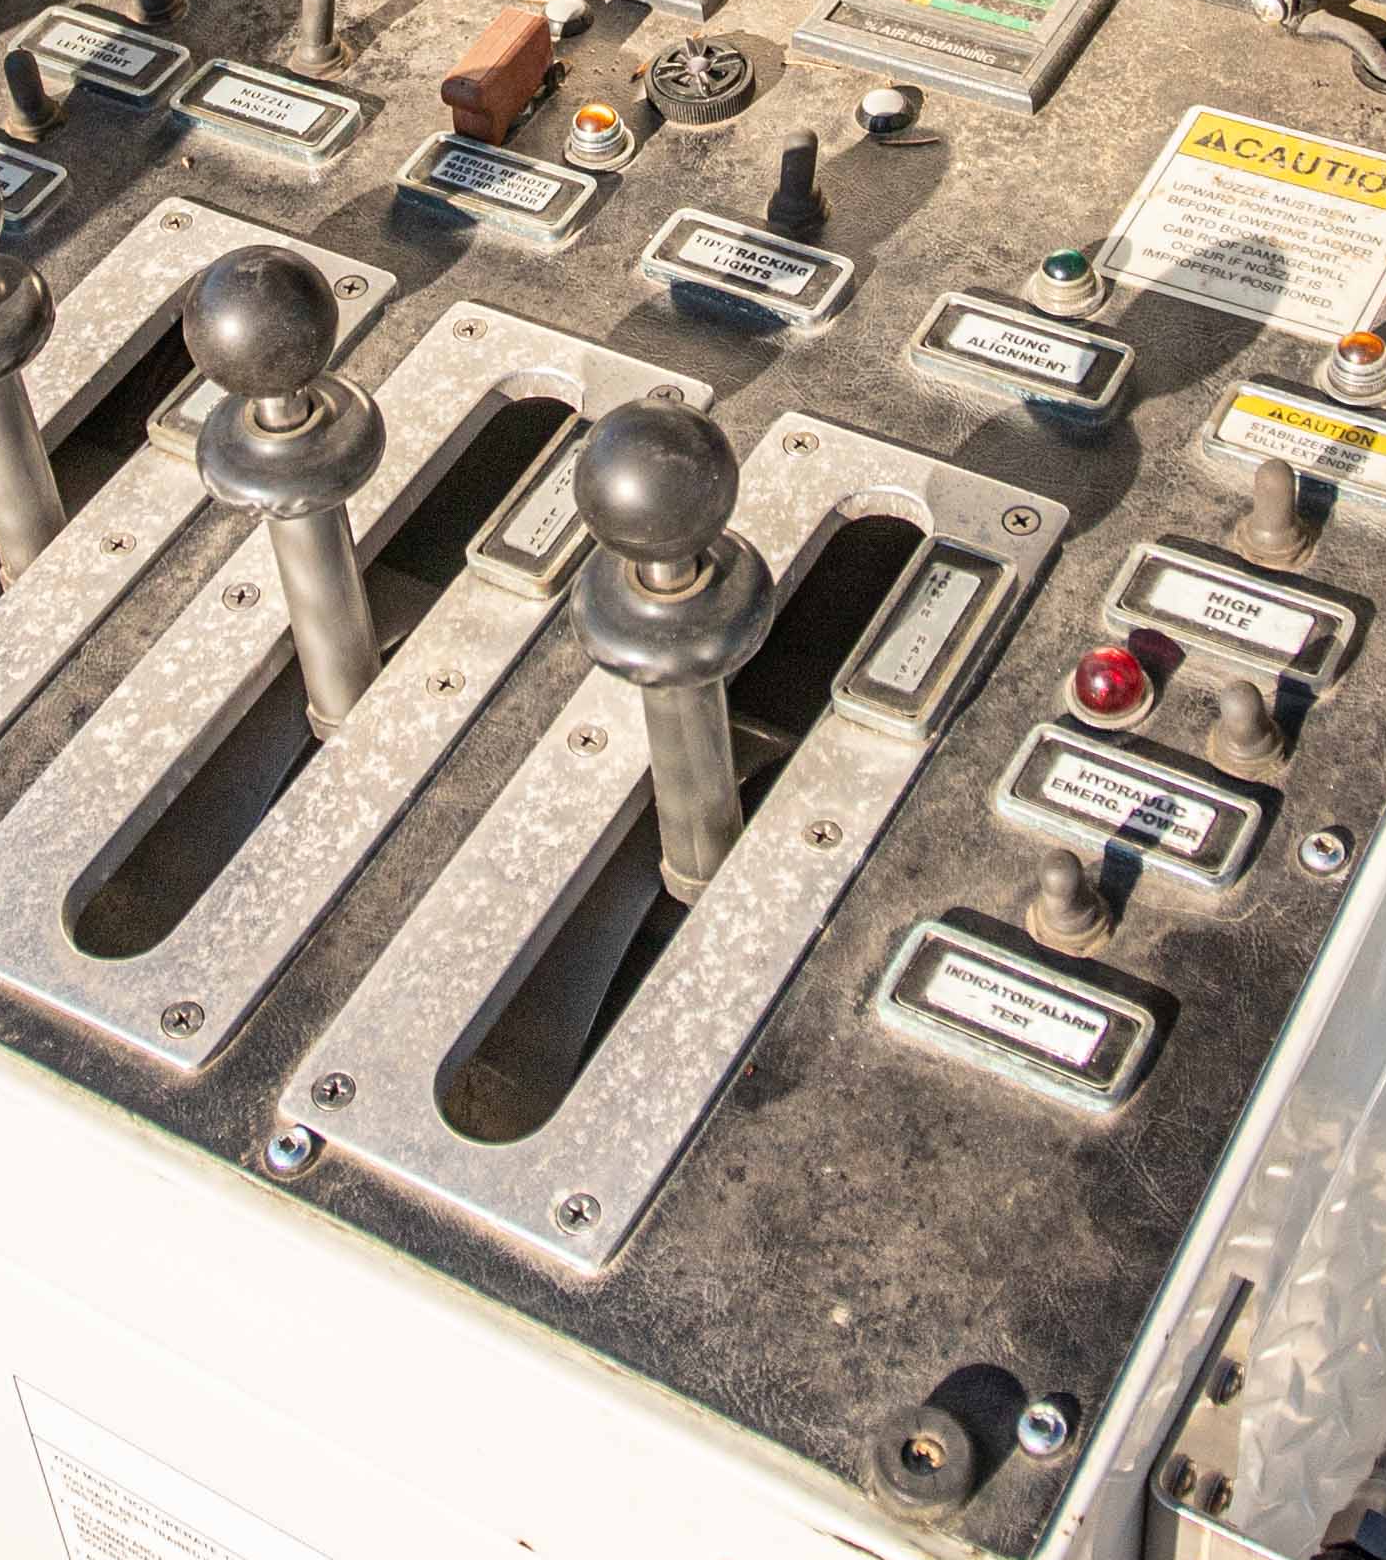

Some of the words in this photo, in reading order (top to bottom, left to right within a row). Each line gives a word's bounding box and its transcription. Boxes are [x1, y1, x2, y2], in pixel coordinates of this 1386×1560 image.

[76, 33, 130, 56] NOZZLE
[879, 24, 907, 39] AIR
[909, 31, 997, 64] REMAINING
[229, 97, 288, 122] MASTER
[240, 87, 295, 110] NOZZLE
[440, 170, 467, 183] AND
[469, 179, 538, 205] INDICATOR
[445, 161, 496, 182] MASTER
[500, 178, 546, 198] SWITCH
[453, 155, 497, 173] AERIAL
[499, 168, 550, 190] REMOTE
[1167, 194, 1227, 217] BEFORE
[1230, 210, 1309, 241] LOWERING
[1313, 234, 1374, 258] LADDER
[1173, 180, 1237, 205] UPWARD
[1238, 199, 1311, 227] POINTING
[1313, 219, 1383, 247] POSITION
[1273, 194, 1315, 213] MUST
[1317, 206, 1338, 219] BE
[1341, 212, 1357, 224] IN
[1182, 213, 1216, 229] INTO
[1220, 224, 1267, 244] BOOM
[696, 234, 809, 277] TIP/TRACKING
[714, 255, 773, 280] LIGHTS
[1163, 224, 1194, 238] CAB
[1197, 233, 1239, 250] ROOF
[1241, 245, 1311, 272] DAMAGE
[1312, 264, 1347, 282] WILL
[1171, 241, 1225, 262] OCCUR
[1228, 257, 1245, 266] IF
[1245, 261, 1306, 285] NOZZLE
[1308, 279, 1323, 291] IS
[1142, 248, 1237, 281] IMPROPERLY
[1240, 276, 1334, 310] POSITIONED.
[966, 336, 1070, 373] ALIGNMENT
[1001, 331, 1051, 354] RUNG
[1251, 421, 1338, 456] STABILIZERS
[1340, 450, 1370, 463] NOT
[1286, 412, 1375, 448] CAUTION
[1245, 432, 1288, 452] FULLY
[1291, 448, 1365, 475] EXTENDED
[1203, 605, 1253, 631] IDLE
[1207, 591, 1262, 617] HIGH
[1050, 778, 1122, 814] EMERG.
[1132, 808, 1199, 842] POWER
[1079, 766, 1187, 820] HYDRAULIC
[945, 964, 1100, 1033] INDICATOR/ALARM
[991, 1004, 1034, 1029] TEST
